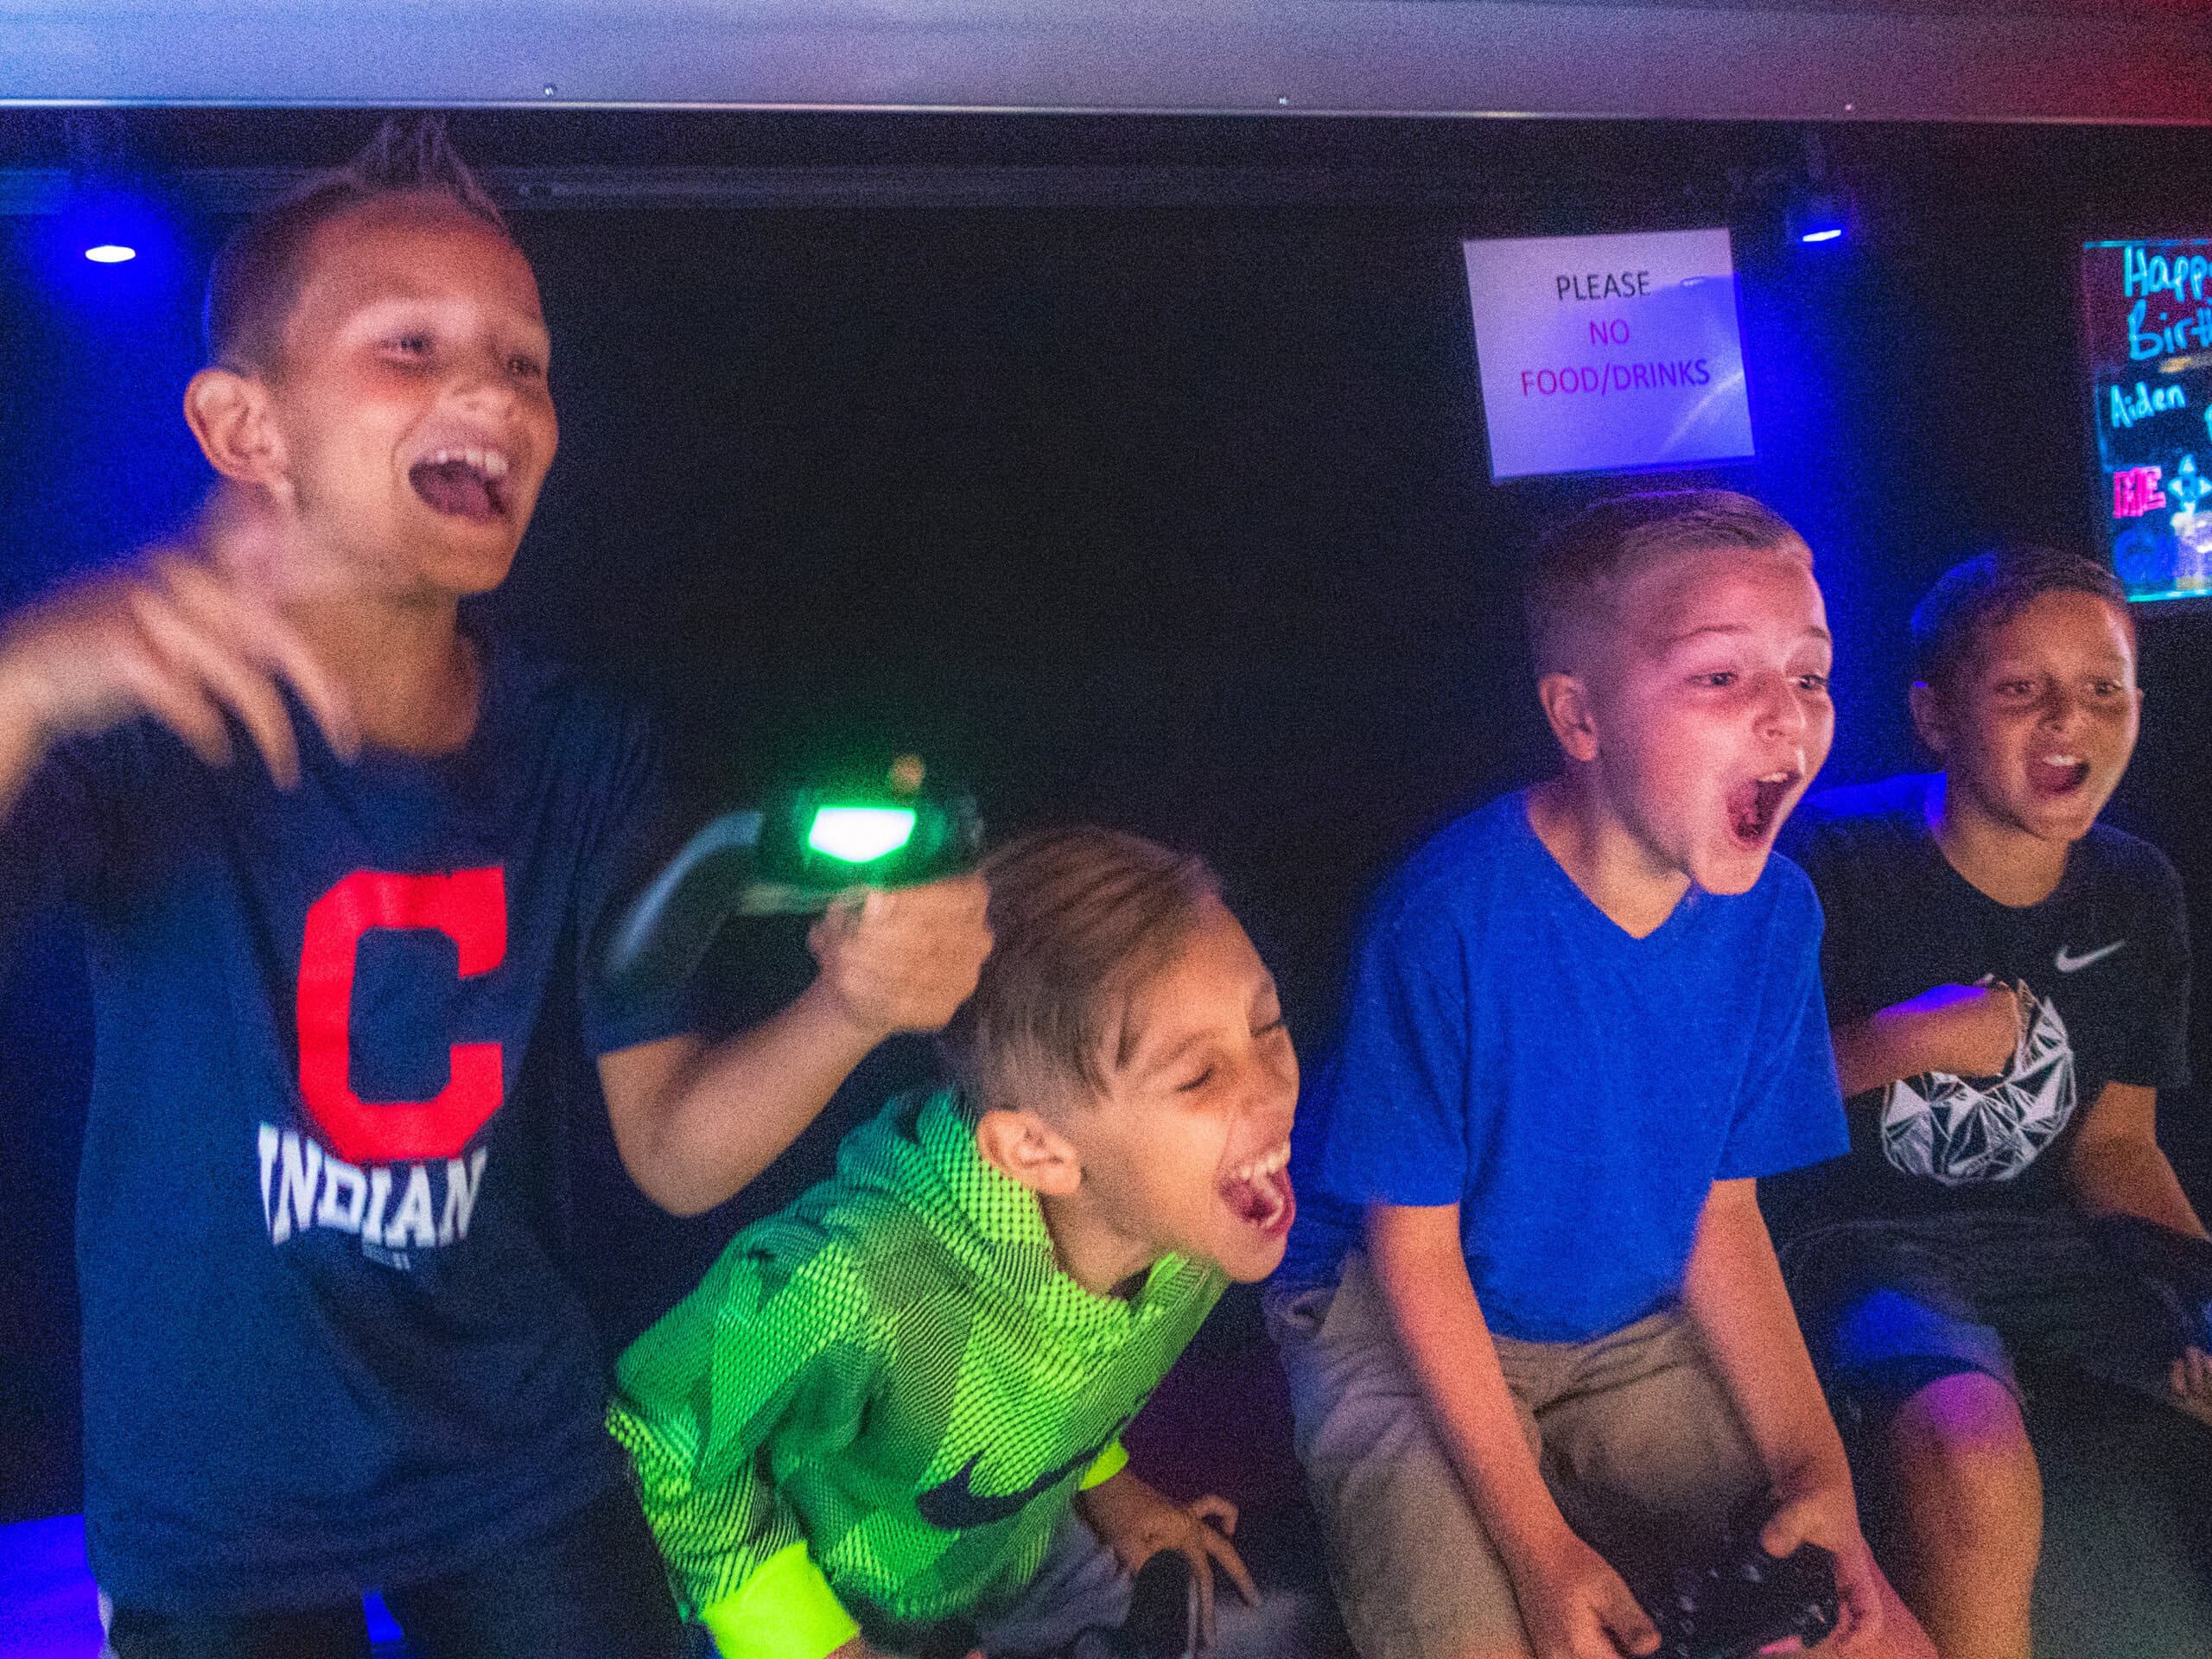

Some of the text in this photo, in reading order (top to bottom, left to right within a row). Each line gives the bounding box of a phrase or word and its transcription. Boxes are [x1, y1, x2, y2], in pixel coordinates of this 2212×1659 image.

[1556, 271, 1650, 301] PLEASE
[2124, 245, 2212, 302] Happ
[1589, 319, 1630, 346] NO
[1521, 359, 1710, 396] FOOD/DRINKS
[2110, 382, 2186, 427] Aiden
[296, 867, 508, 1163] C
